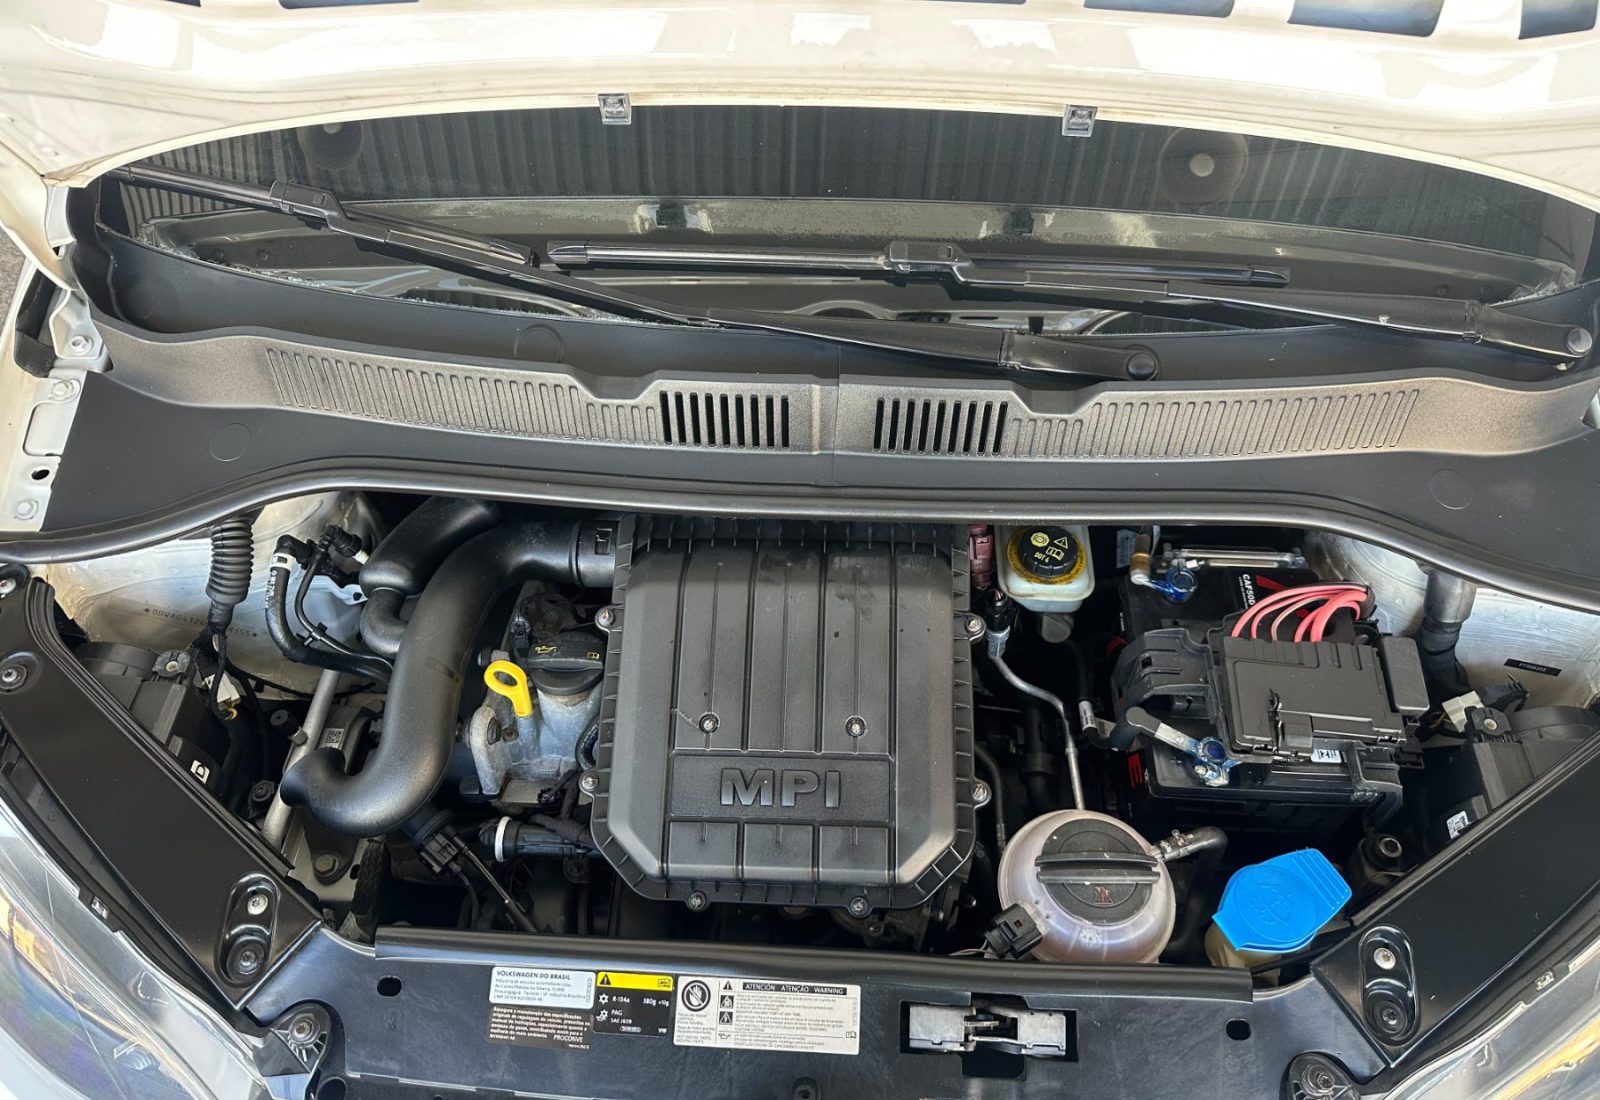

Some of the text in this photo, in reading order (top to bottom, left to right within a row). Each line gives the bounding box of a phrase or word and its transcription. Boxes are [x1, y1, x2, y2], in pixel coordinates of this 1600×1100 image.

[1034, 551, 1046, 560] DOT
[721, 768, 840, 808] MPI
[497, 970, 538, 978] VOLKSWAGEN
[745, 983, 844, 995] ATENCIÓN ATENÇÃO WARNING
[553, 1034, 583, 1043] PROCONVE
